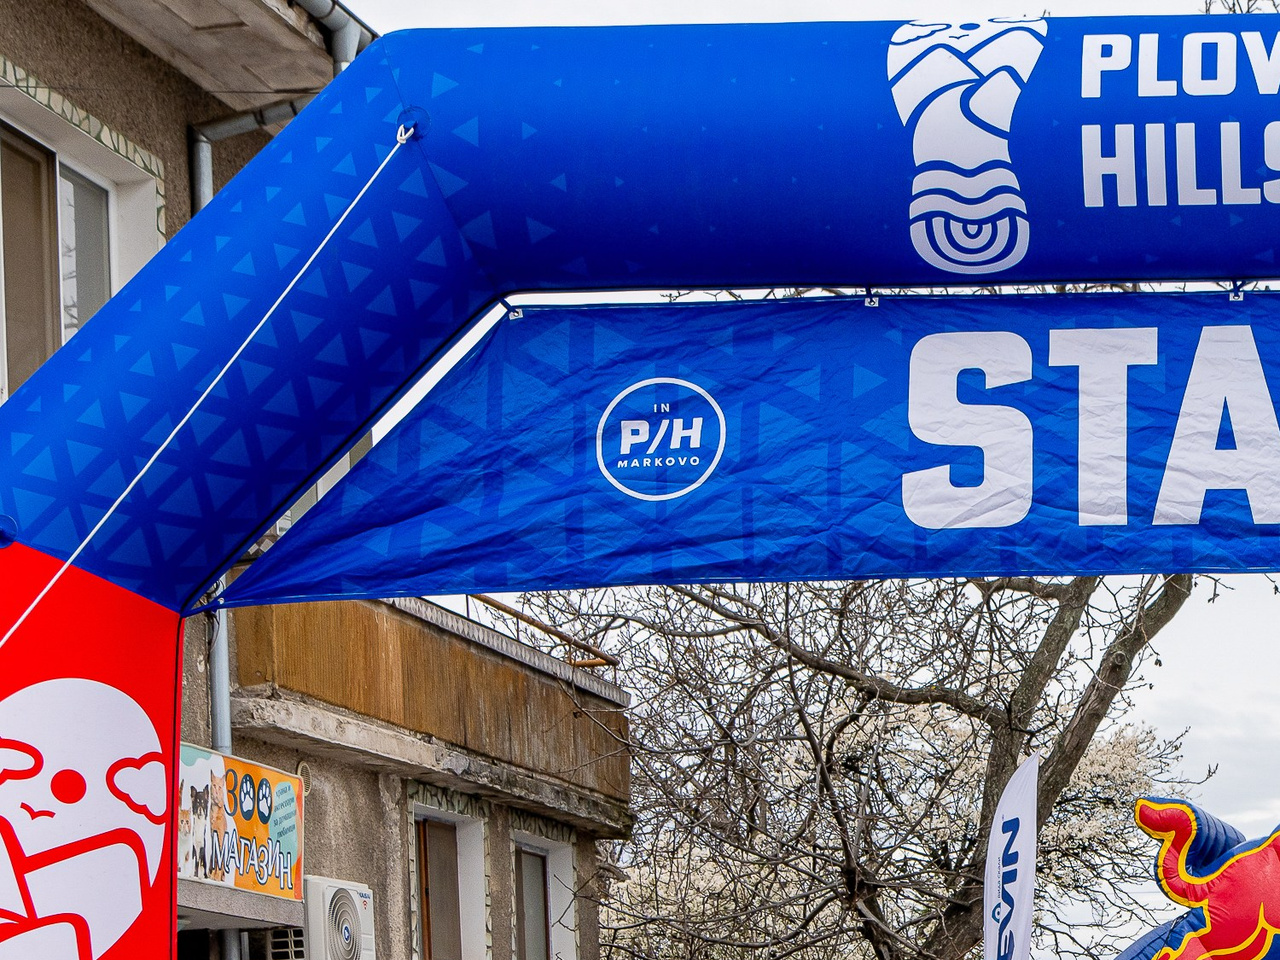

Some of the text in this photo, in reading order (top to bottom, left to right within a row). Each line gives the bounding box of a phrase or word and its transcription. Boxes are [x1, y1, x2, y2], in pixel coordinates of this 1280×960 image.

[653, 403, 670, 413] IN
[620, 417, 703, 455] P/H
[617, 456, 700, 468] MARKOVO
[211, 828, 293, 890] МАГАЗИН
